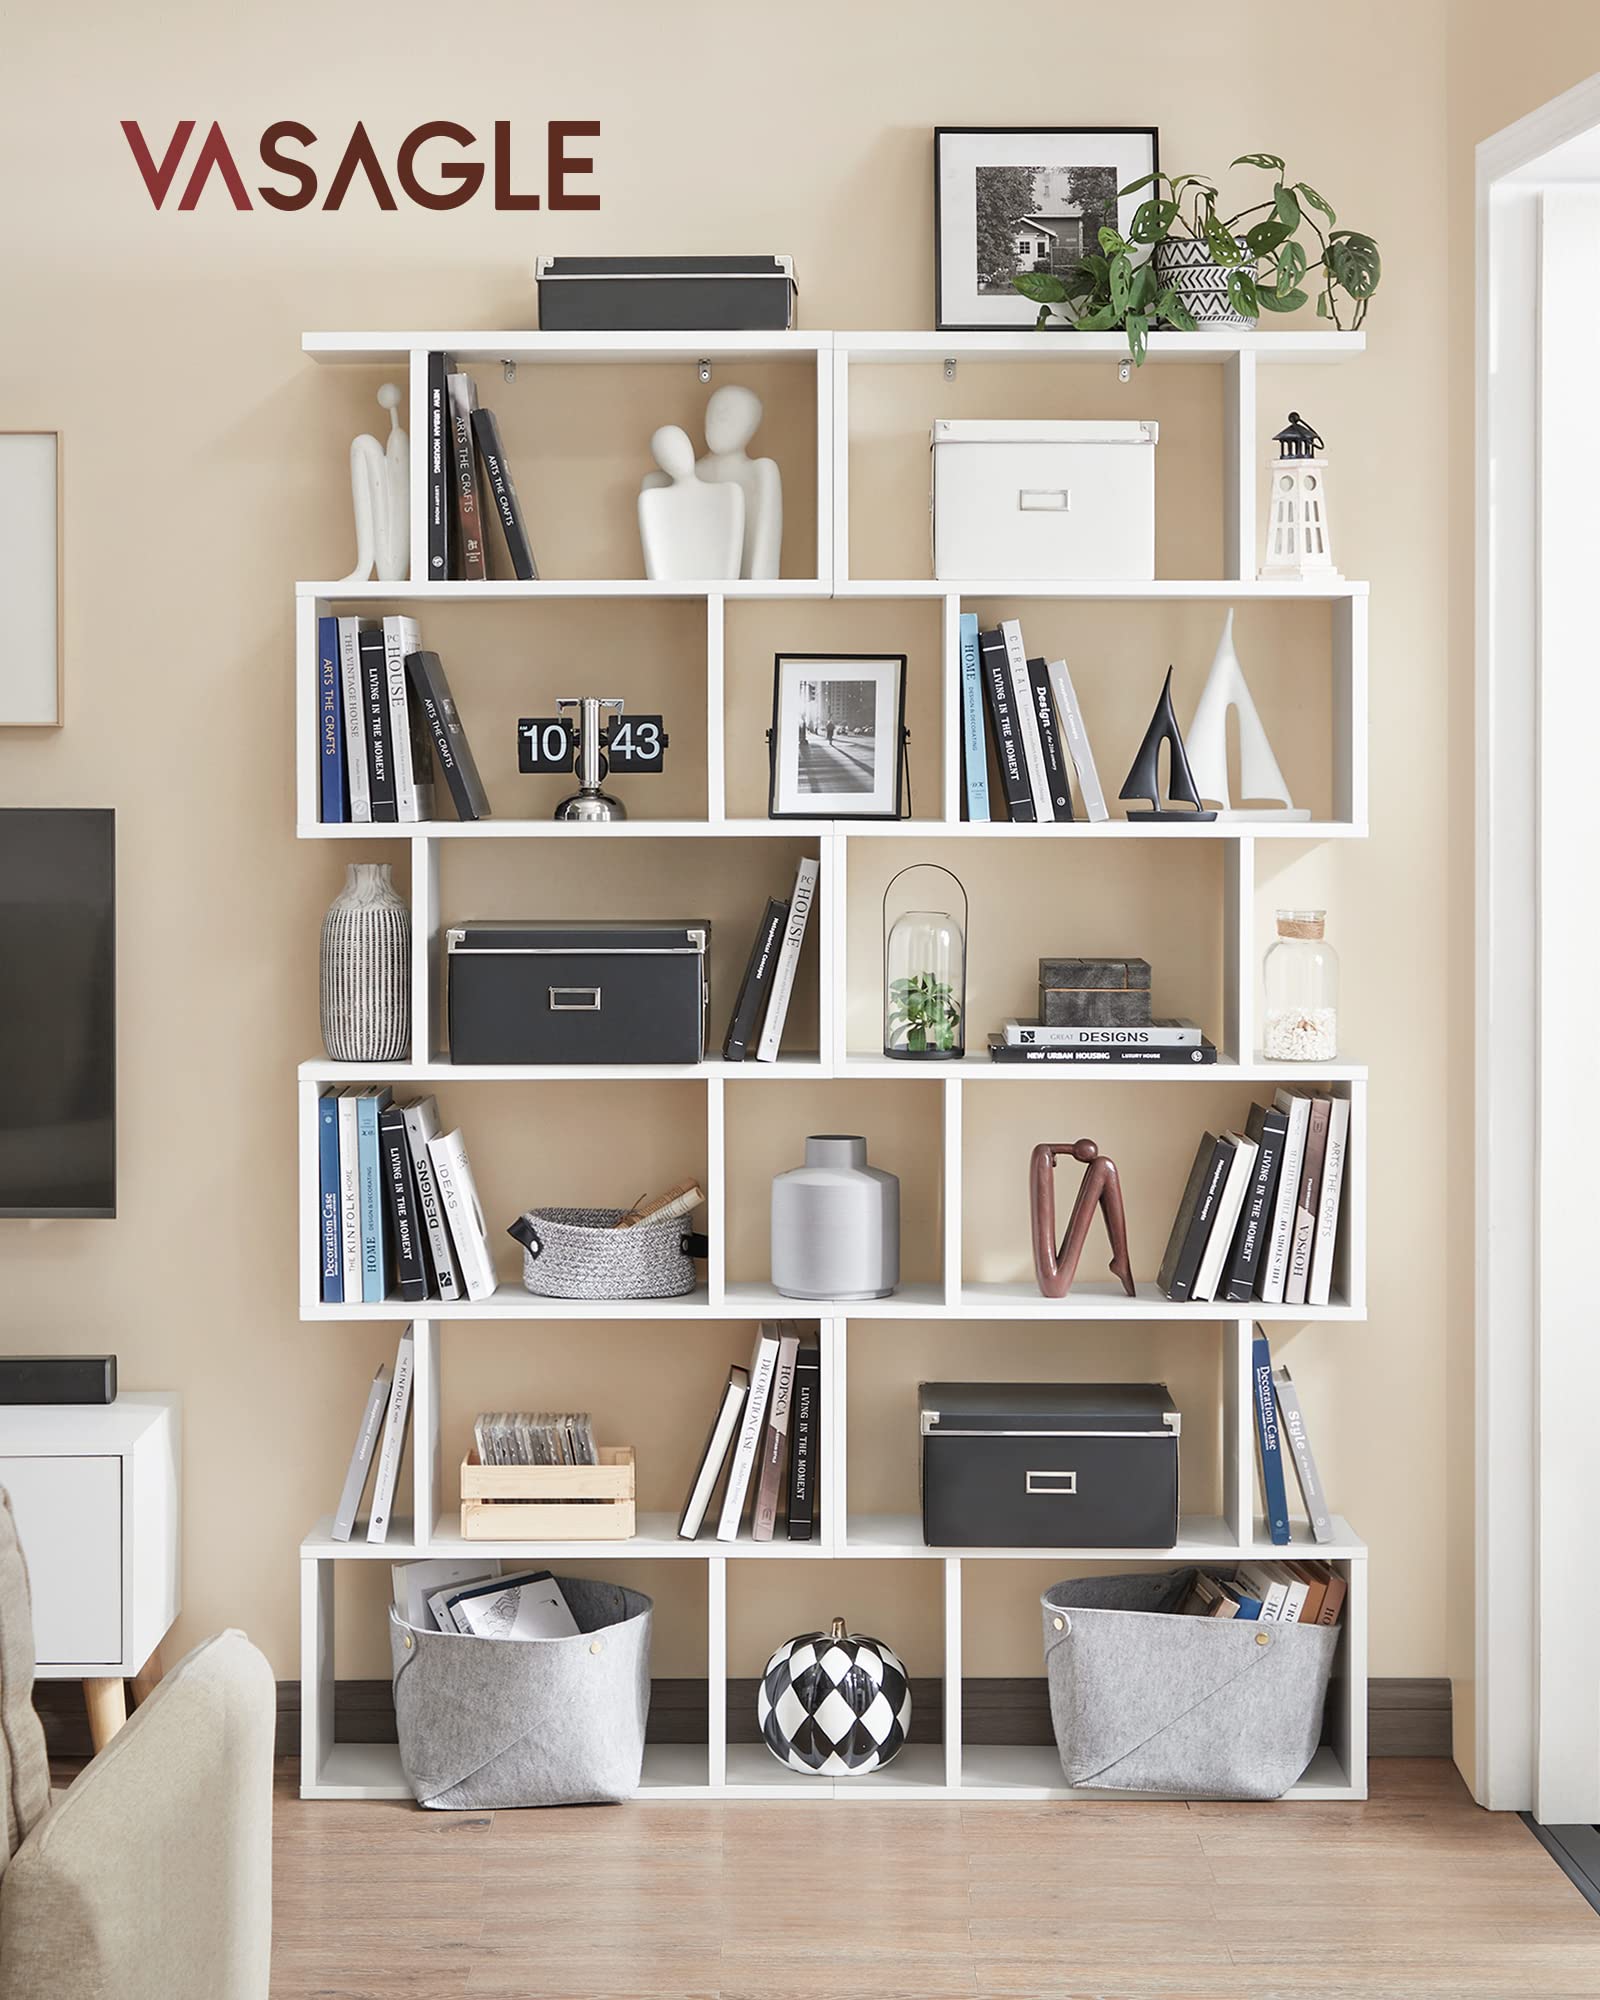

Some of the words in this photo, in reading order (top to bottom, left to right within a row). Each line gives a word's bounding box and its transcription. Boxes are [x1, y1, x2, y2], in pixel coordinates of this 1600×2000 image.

[433, 389, 441, 407] NEW
[433, 410, 441, 436] URBAN
[456, 416, 468, 444] ARTS
[433, 439, 441, 474] HOUSING
[459, 447, 470, 469] THE
[488, 455, 499, 476] ARTS
[460, 474, 474, 513] CRAFTS
[493, 476, 505, 494] THE
[499, 496, 514, 526] CRAFTS
[343, 633, 353, 654] THE
[387, 635, 400, 643] PC
[323, 658, 333, 686] ARTS
[345, 655, 356, 702] VINTAGE
[388, 647, 405, 708] HOUSE
[964, 644, 976, 681] HOME
[1009, 636, 1027, 694] CEREAL
[325, 689, 334, 711] THE
[369, 668, 380, 701] LIVING
[967, 685, 975, 707] DESIGN
[992, 668, 1005, 700] LIVING
[348, 702, 359, 737] HOUSE
[371, 704, 380, 714] IN
[998, 703, 1008, 714] IN
[1036, 686, 1051, 729] Design
[325, 716, 336, 755] CRAFTS
[372, 717, 382, 739] THE
[424, 699, 436, 719] ARTS
[431, 719, 444, 737] THE
[438, 737, 454, 768] CRAFTS
[523, 724, 567, 761] 10
[611, 723, 661, 760] 43
[969, 713, 977, 751] DECORATING
[1001, 716, 1013, 737] THE
[373, 743, 385, 782] MOMENT
[1004, 740, 1020, 781] MOMENT
[800, 875, 814, 885] PC
[786, 887, 811, 949] HOUSE
[763, 917, 779, 953] Metaphorical
[756, 953, 769, 980] Concepts
[1050, 1033, 1074, 1041] GREAT
[1079, 1032, 1149, 1043] DESIGNS
[1027, 1052, 1045, 1060] NEW
[1047, 1052, 1073, 1060] URBAN
[1075, 1052, 1110, 1060] HOUSING
[390, 1147, 402, 1180] LIVING
[1258, 1150, 1273, 1183] LIVING
[1329, 1142, 1342, 1168] ARTS
[365, 1165, 373, 1203] DECORATING
[393, 1182, 404, 1193] IN
[439, 1163, 458, 1209] IDEAS
[1209, 1159, 1224, 1195] Metaphorical
[1256, 1185, 1265, 1195] IN
[1326, 1171, 1339, 1193] THE
[323, 1191, 333, 1217] Case
[395, 1196, 407, 1217] THE
[417, 1159, 439, 1229] DESIGNS
[1200, 1194, 1214, 1221] Concepts
[1251, 1198, 1264, 1218] THE
[345, 1193, 356, 1253] KINFOLK
[1321, 1197, 1337, 1238] CRAFTS
[324, 1219, 334, 1276] Decoration
[365, 1236, 377, 1272] HOME
[398, 1219, 413, 1260] MOMENT
[1243, 1220, 1259, 1262] MOMENT
[1274, 1233, 1285, 1263] STORY
[1294, 1225, 1310, 1276] HOPSCA
[348, 1256, 356, 1271] THE
[394, 1367, 407, 1411] KINFOLK
[748, 1358, 771, 1426] DECORATION
[775, 1365, 791, 1417] HOPSCA
[800, 1387, 810, 1420] LIVING
[1259, 1365, 1274, 1423] Decoration
[742, 1425, 756, 1453] CASE
[800, 1422, 809, 1433] IN
[1266, 1423, 1278, 1451] Case
[1288, 1410, 1307, 1450] Style
[798, 1436, 807, 1456] THE
[796, 1459, 807, 1500] MOMENT
